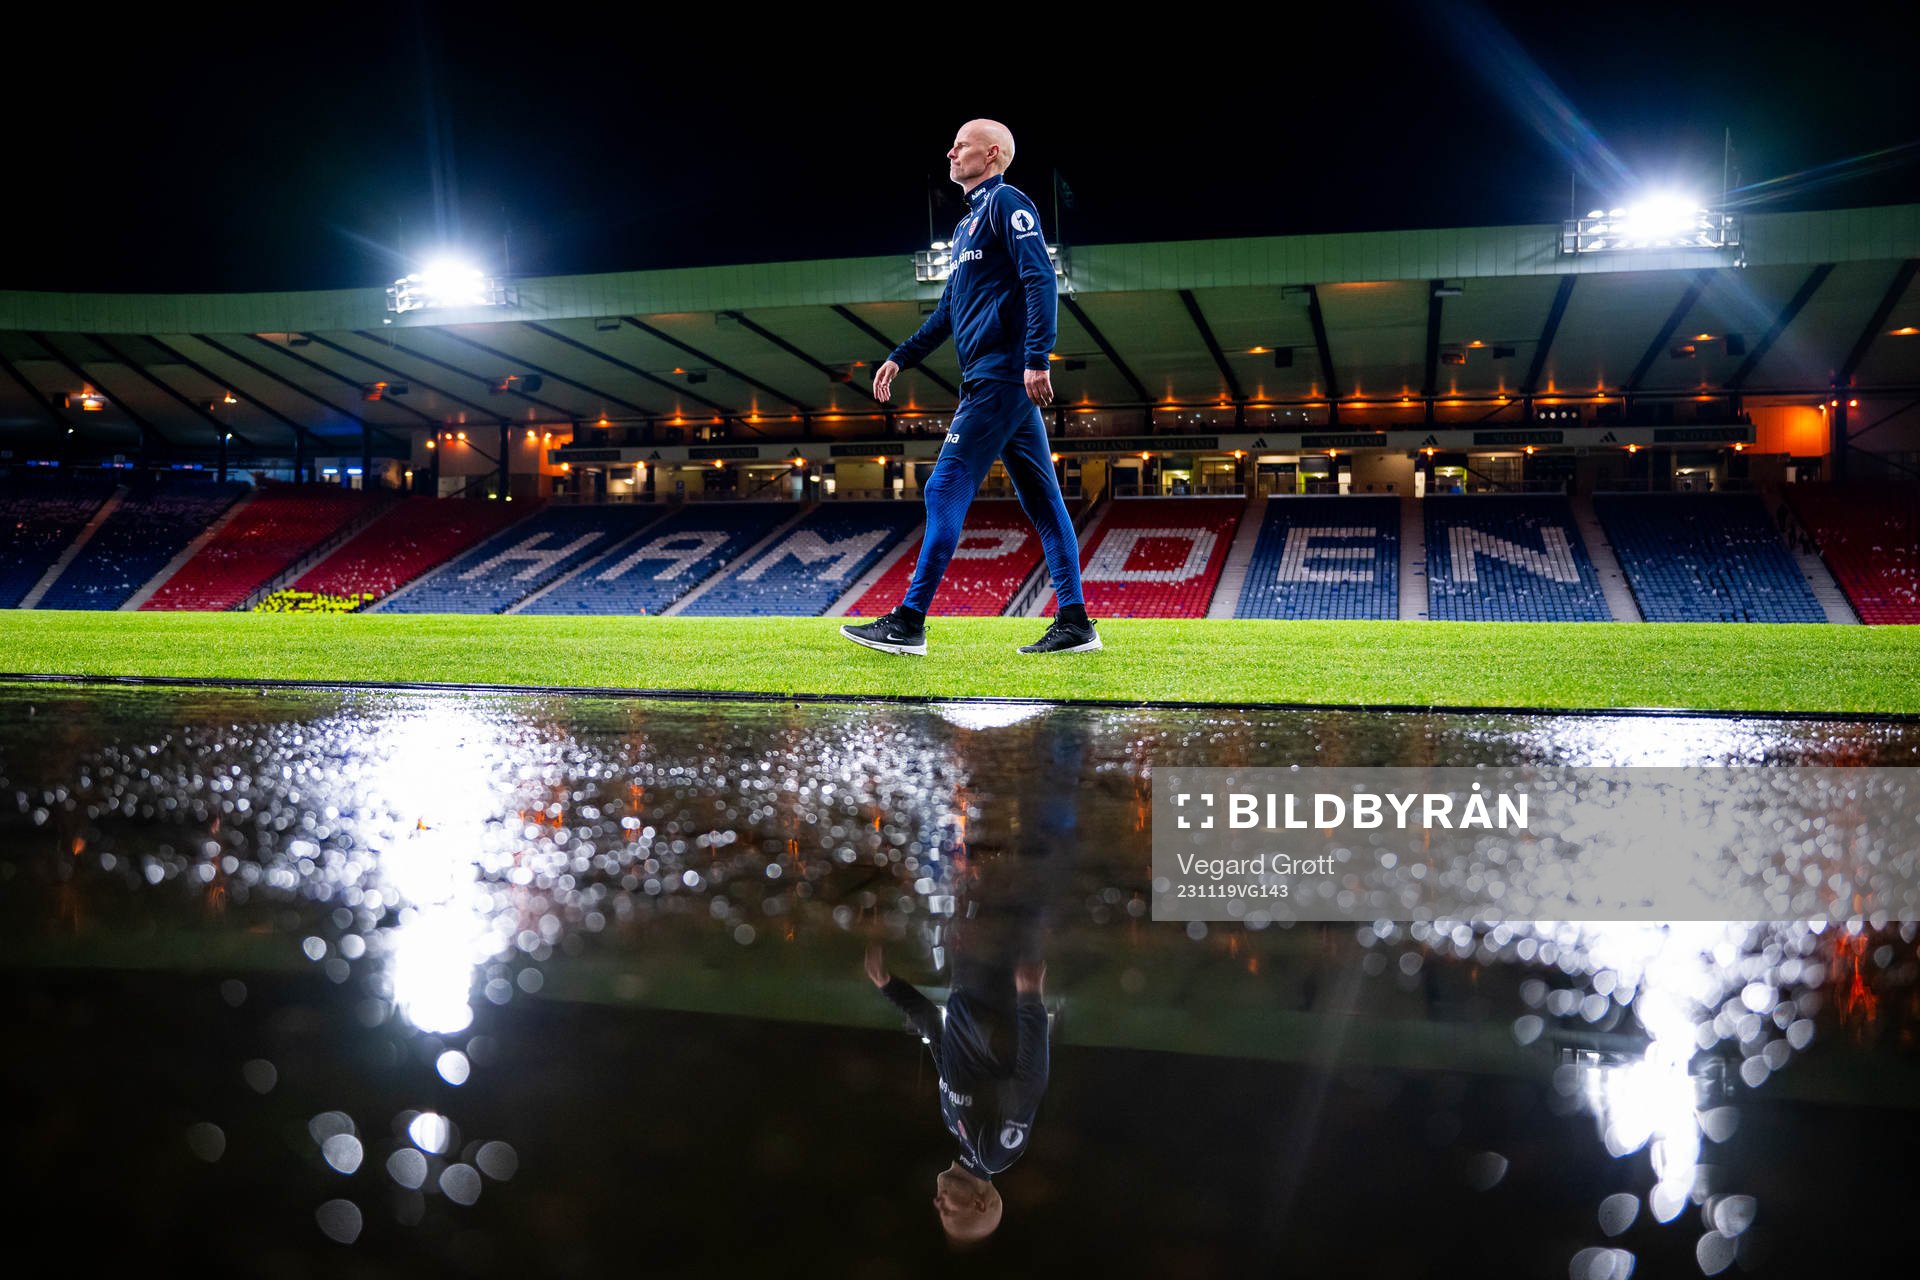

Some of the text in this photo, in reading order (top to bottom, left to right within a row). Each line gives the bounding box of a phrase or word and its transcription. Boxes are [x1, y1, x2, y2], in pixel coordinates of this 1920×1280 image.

[1074, 440, 1134, 451] SCOTLAND
[1154, 438, 1216, 449] SCOTLAND
[457, 525, 1582, 583] HAMPDEN
